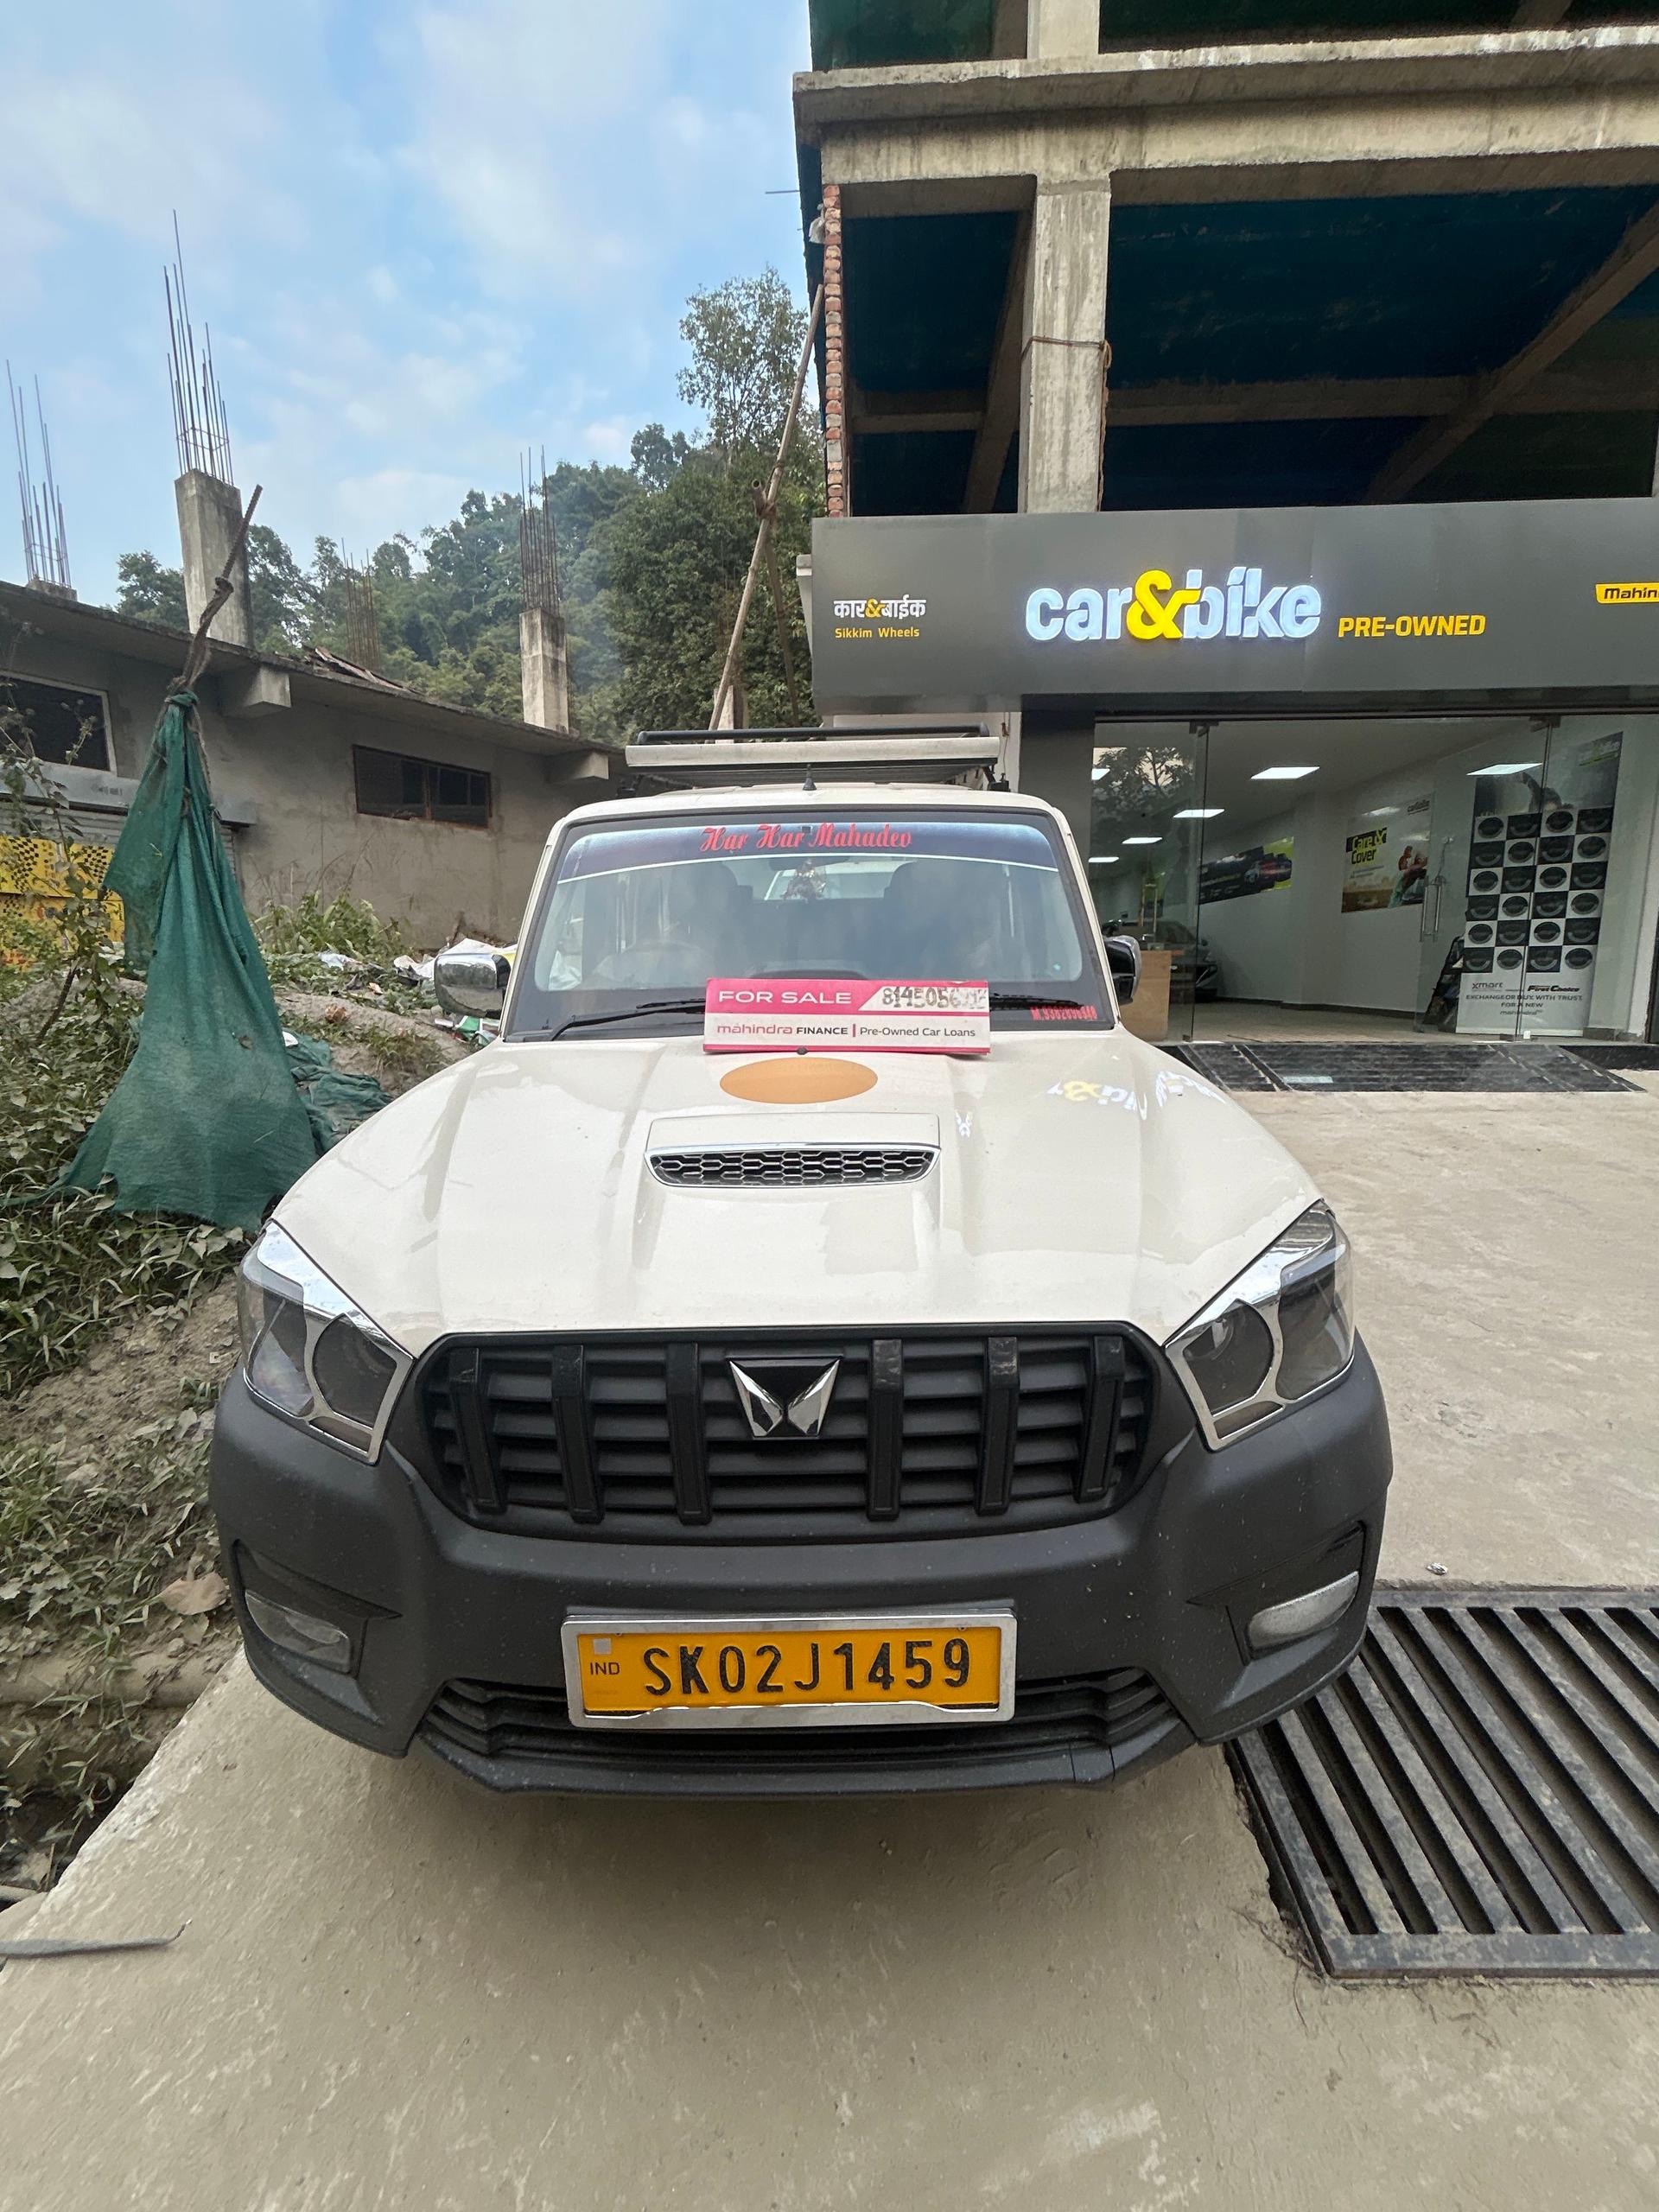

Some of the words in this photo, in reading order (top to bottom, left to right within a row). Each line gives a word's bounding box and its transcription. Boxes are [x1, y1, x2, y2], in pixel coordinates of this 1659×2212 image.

[1604, 588, 1659, 599] Mahin
[833, 594, 927, 620] कार&बाईक
[1025, 566, 1322, 641] car&bike
[835, 627, 873, 639] Sikkim
[878, 626, 920, 638] Wheels
[1338, 614, 1486, 638] PRE-OWNED
[701, 826, 747, 852] Har
[756, 823, 804, 849] Har
[808, 822, 912, 849] Mahadev
[1351, 834, 1375, 849] Care
[1351, 849, 1377, 865] Cover
[718, 990, 774, 1003] FOR
[781, 991, 852, 1004] SALE
[717, 1024, 793, 1034] mahindra
[796, 1027, 849, 1035] FINANCE
[860, 1027, 919, 1036] Pre-Owned
[922, 1027, 941, 1036] Car
[944, 1027, 976, 1037] Loans
[590, 1662, 620, 1675] IND
[643, 1637, 971, 1695] SK02J1459
